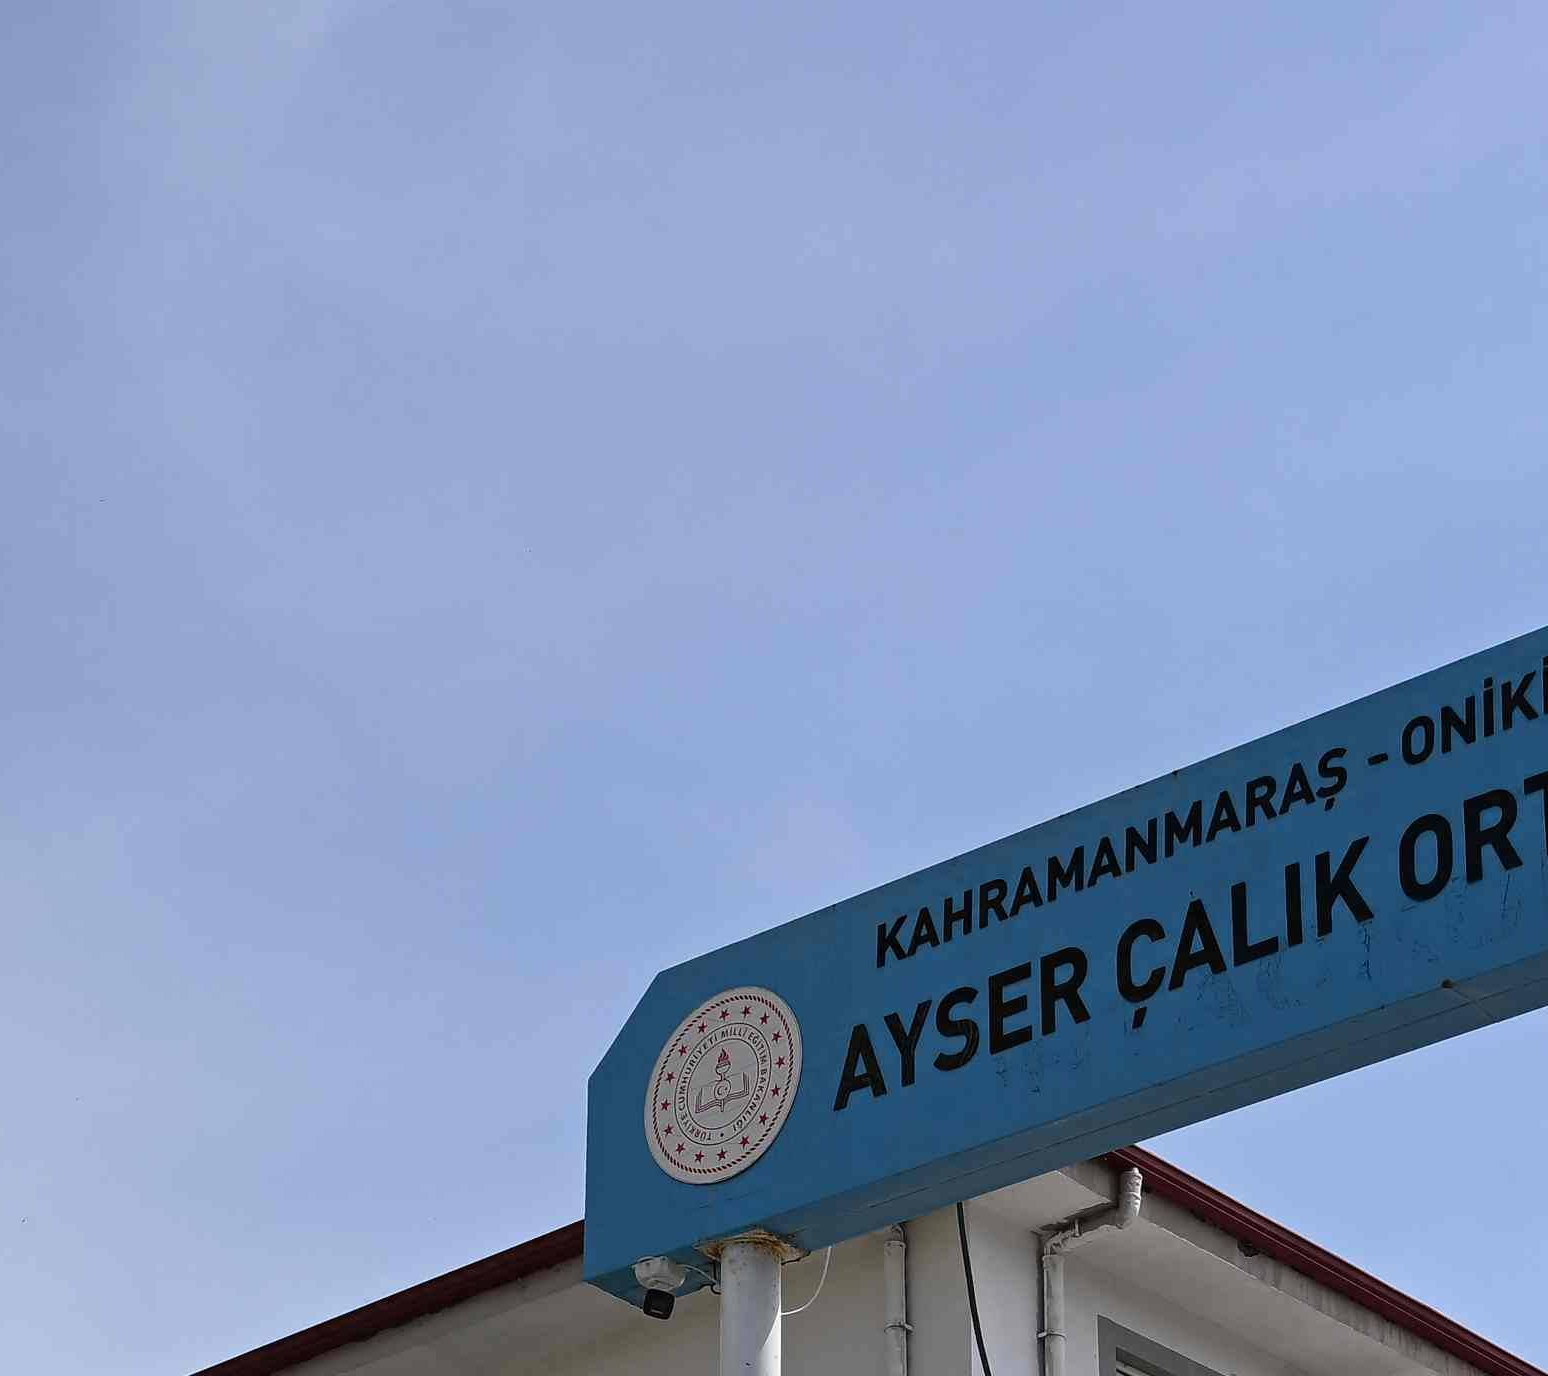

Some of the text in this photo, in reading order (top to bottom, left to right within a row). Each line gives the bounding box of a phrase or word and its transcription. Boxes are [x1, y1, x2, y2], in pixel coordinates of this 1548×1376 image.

[833, 946, 1091, 1112] AYSER
[1116, 835, 1375, 1030] ÇALIK
[876, 747, 1349, 968] KAHRAMANMARAŞ
